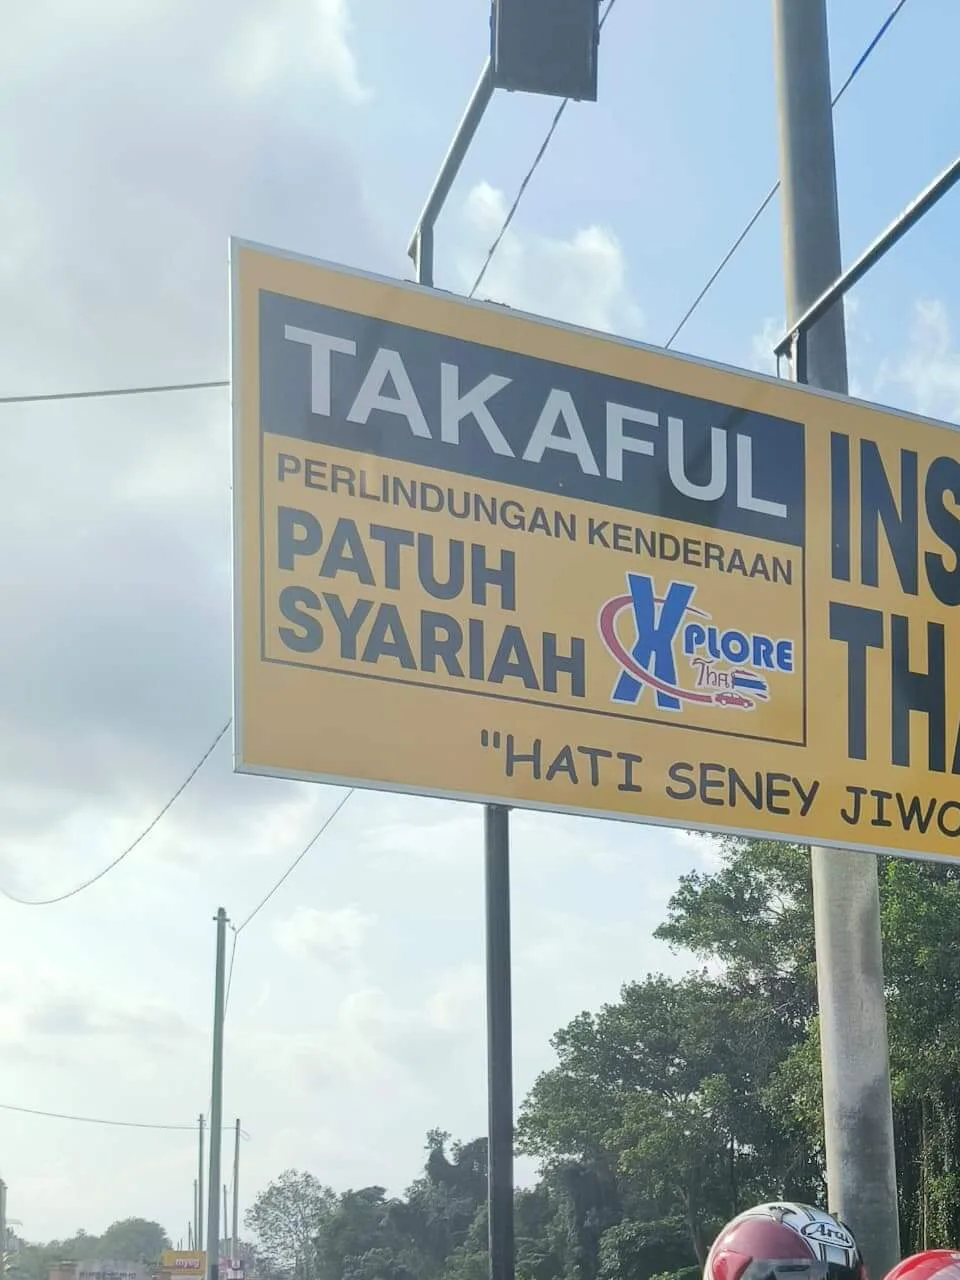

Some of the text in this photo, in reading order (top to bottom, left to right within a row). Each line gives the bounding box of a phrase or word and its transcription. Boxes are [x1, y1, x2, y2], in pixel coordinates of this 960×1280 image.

[284, 323, 788, 519] TAKAFUL
[276, 451, 793, 585] PERLINDUNGAN KENDERAAN
[277, 505, 516, 612] PATUH
[277, 586, 586, 698] SYARIAH
[480, 728, 643, 793] "HATI
[665, 761, 821, 817] SENEY
